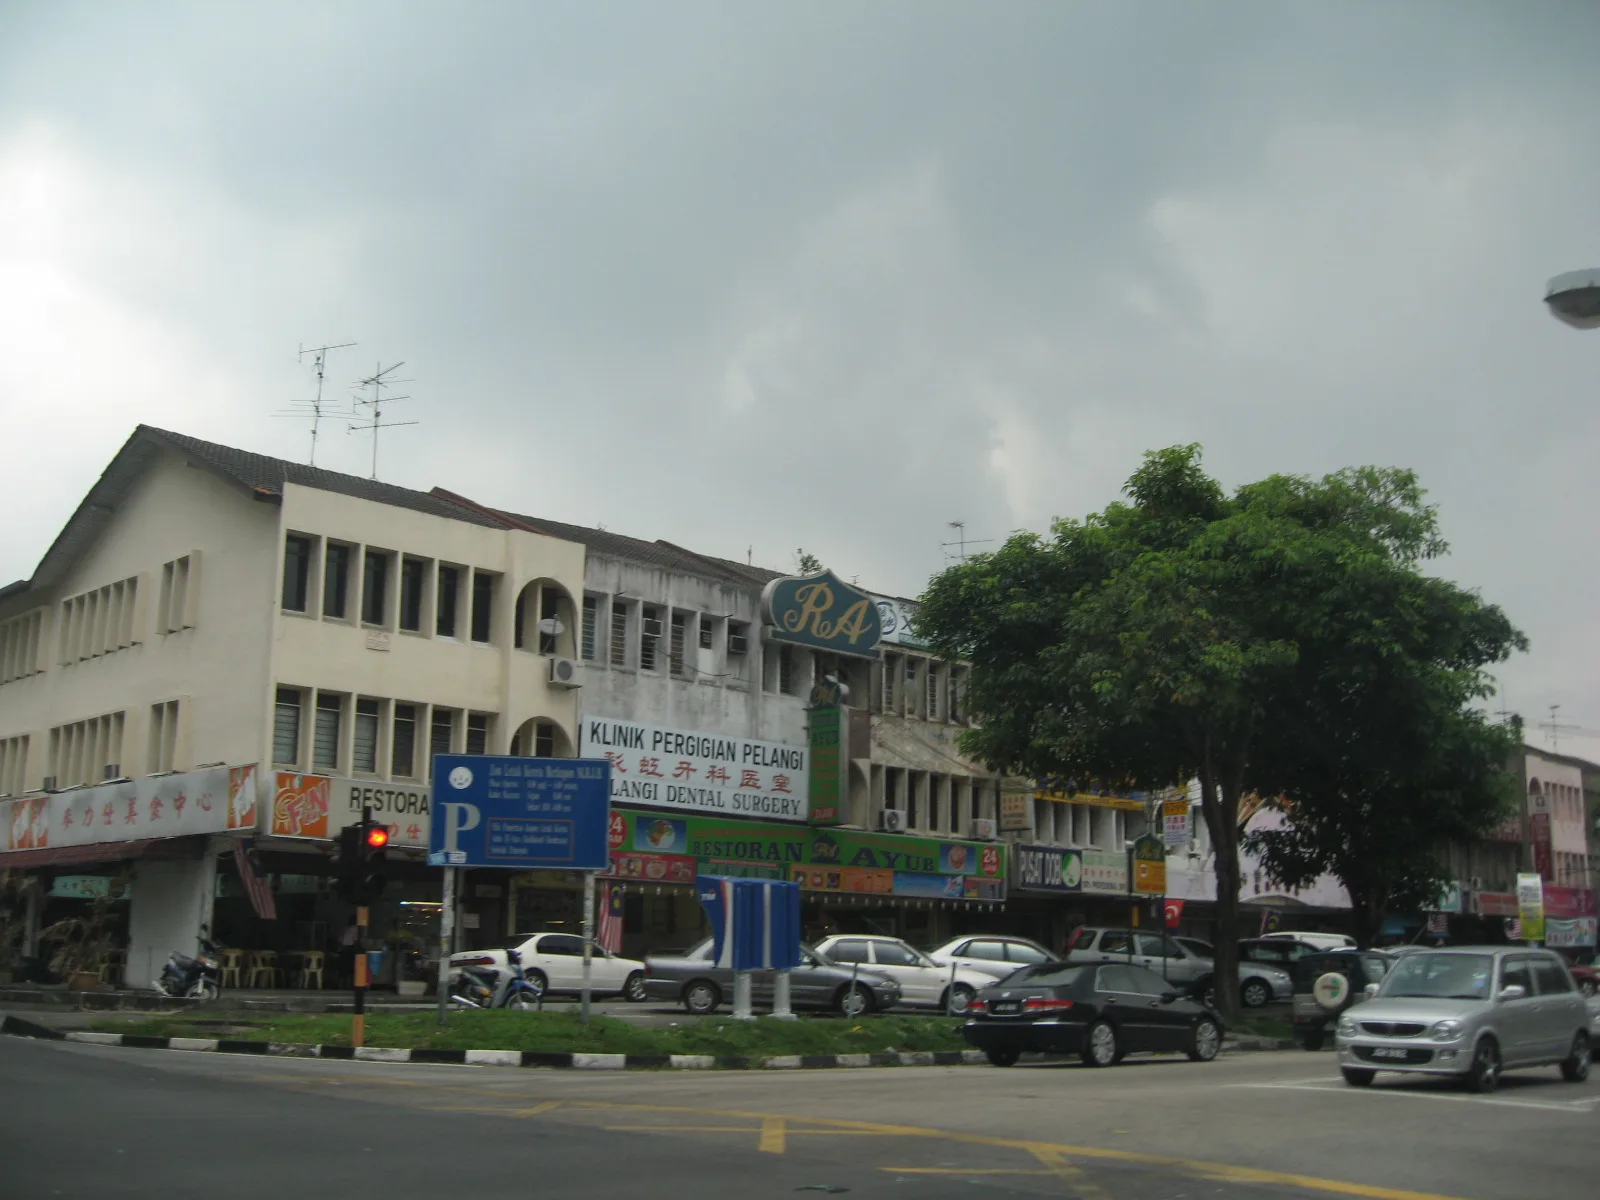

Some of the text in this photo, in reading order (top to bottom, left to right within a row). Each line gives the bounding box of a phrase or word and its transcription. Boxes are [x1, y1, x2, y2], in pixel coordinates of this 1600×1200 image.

[590, 721, 804, 771] KLINIK PERGIGIAN PELANGI
[350, 787, 430, 816] RESTORA
[610, 778, 659, 801] LANGI
[666, 785, 726, 808] DENTAL
[732, 792, 801, 816] SURGERY
[439, 802, 481, 853] P
[692, 840, 805, 863] RESTORAN
[848, 846, 935, 873] AYUB
[983, 849, 998, 864] 24
